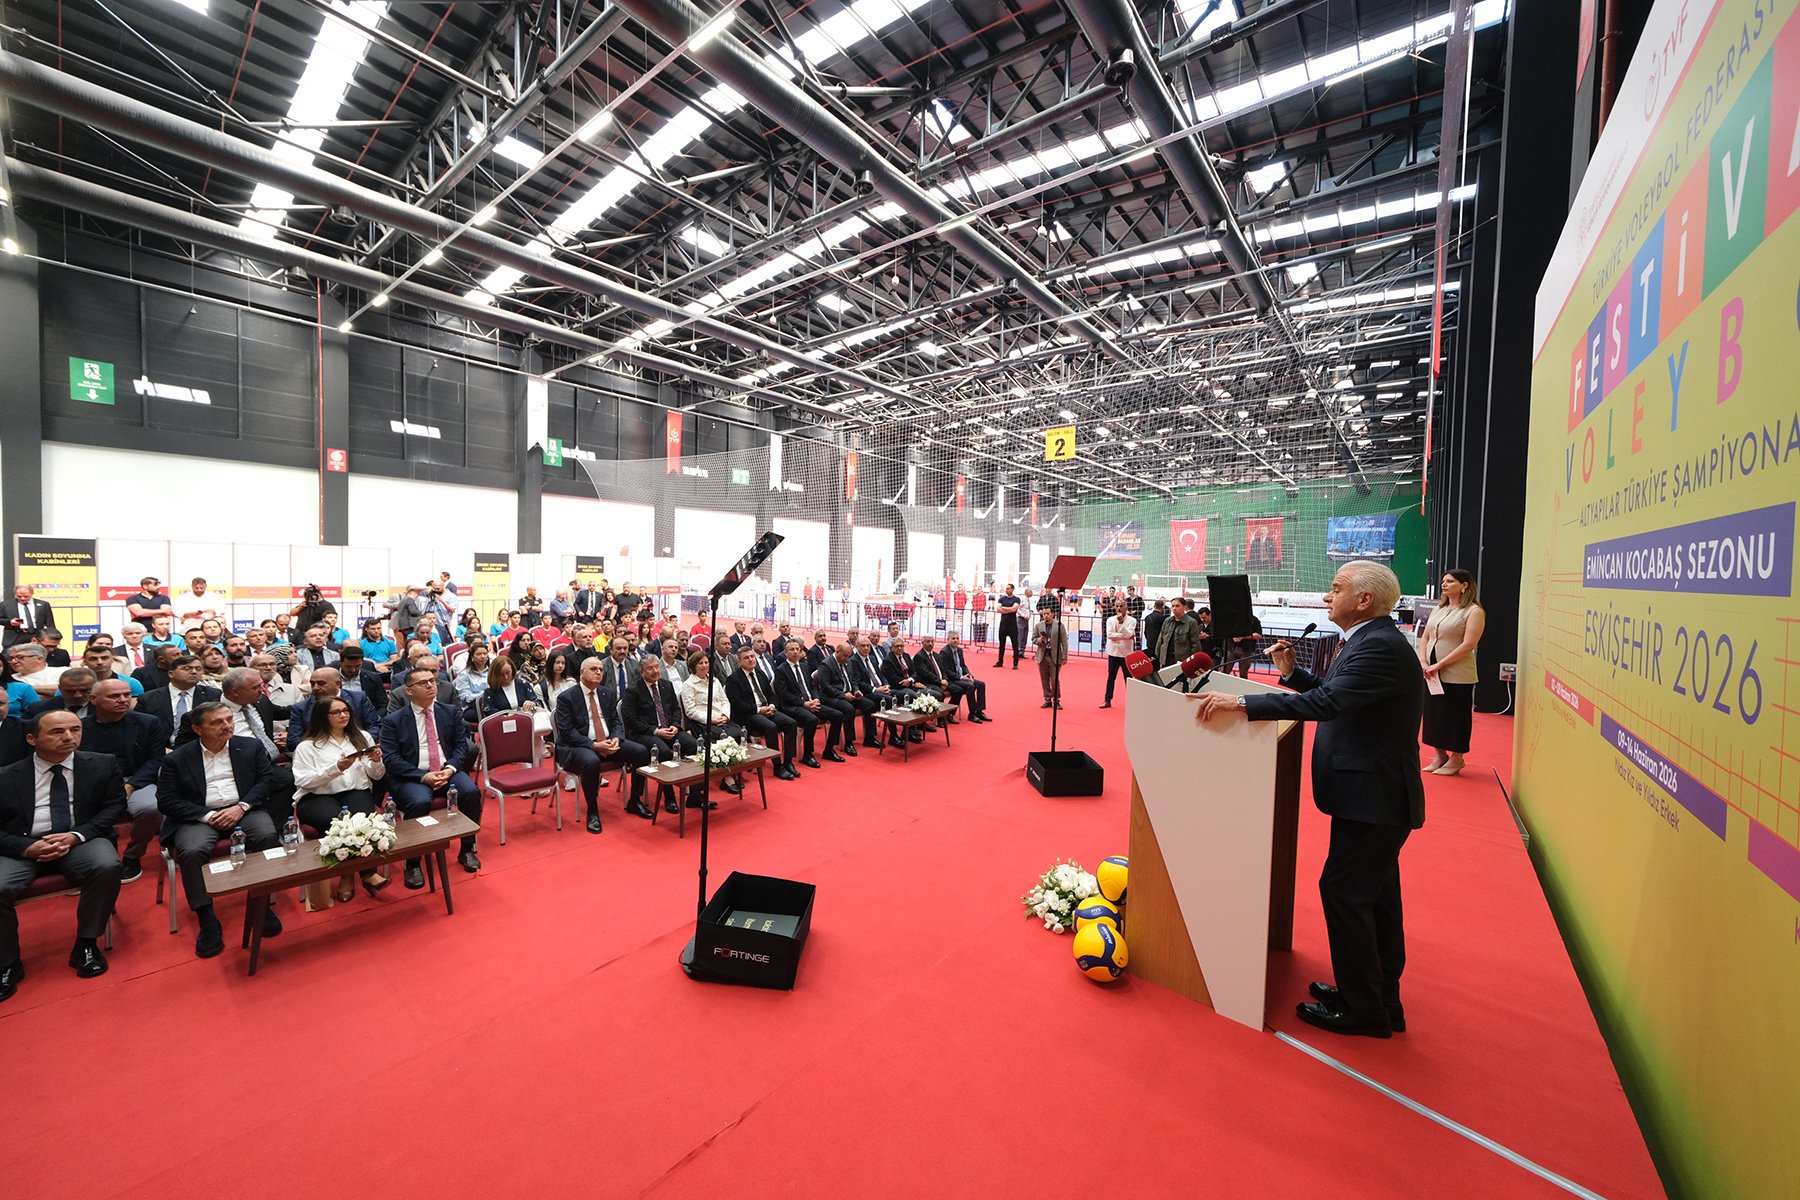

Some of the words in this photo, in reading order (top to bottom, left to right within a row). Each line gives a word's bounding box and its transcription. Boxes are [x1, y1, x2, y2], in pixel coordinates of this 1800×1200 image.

[1663, 0, 1688, 77] TVF
[1593, 239, 1622, 304] TÜRKİYE
[1625, 141, 1679, 251] VOLEYBOL
[1566, 283, 1800, 494] VOLEYB
[1055, 438, 1066, 457] 2
[1579, 491, 1620, 528] ALTYAPILAR
[1624, 468, 1667, 514] TÜRKİYE
[1586, 548, 1624, 580] EMİNCAN
[1625, 544, 1683, 589] KOCABAŞ
[1687, 532, 1775, 580] SEZONU
[1130, 659, 1148, 670] DHA
[1584, 601, 1662, 686] ESKİŞEHİR
[1673, 626, 1762, 725] 2026
[1617, 729, 1633, 757] 09-14
[1633, 741, 1658, 778] Haziran
[1658, 761, 1678, 793] 2026
[1643, 782, 1659, 813] Yıldız
[1661, 798, 1680, 833] Erkek
[713, 947, 770, 963] FORTINGE
